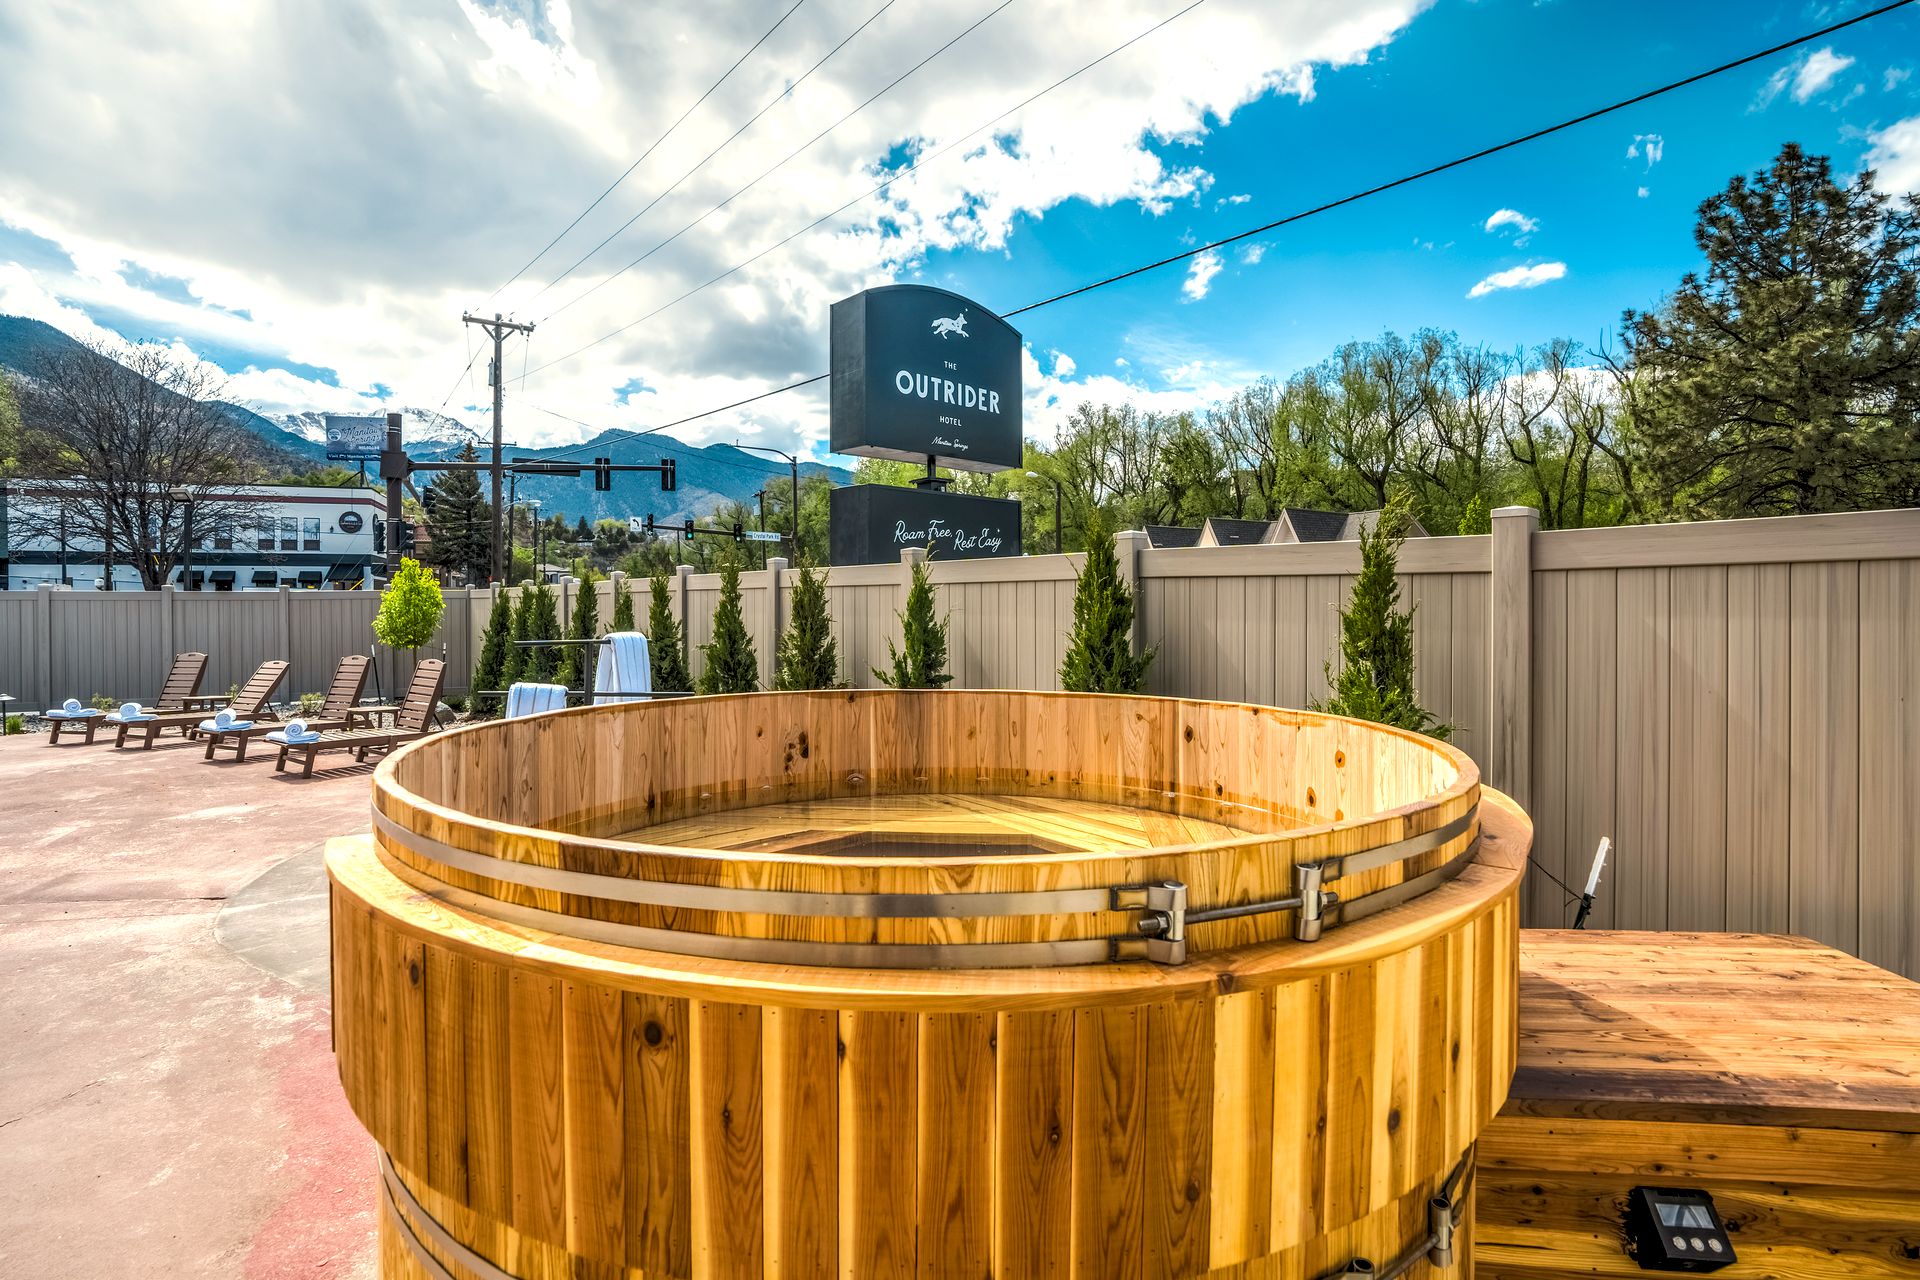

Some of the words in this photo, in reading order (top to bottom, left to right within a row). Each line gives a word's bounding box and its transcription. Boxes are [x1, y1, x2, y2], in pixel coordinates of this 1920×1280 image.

[944, 360, 958, 371] THE
[895, 370, 1000, 414] OUTRIDER
[939, 415, 962, 427] HOTEL
[894, 520, 926, 543] Roam
[953, 529, 977, 551] Rest
[978, 528, 1002, 553] Easy
